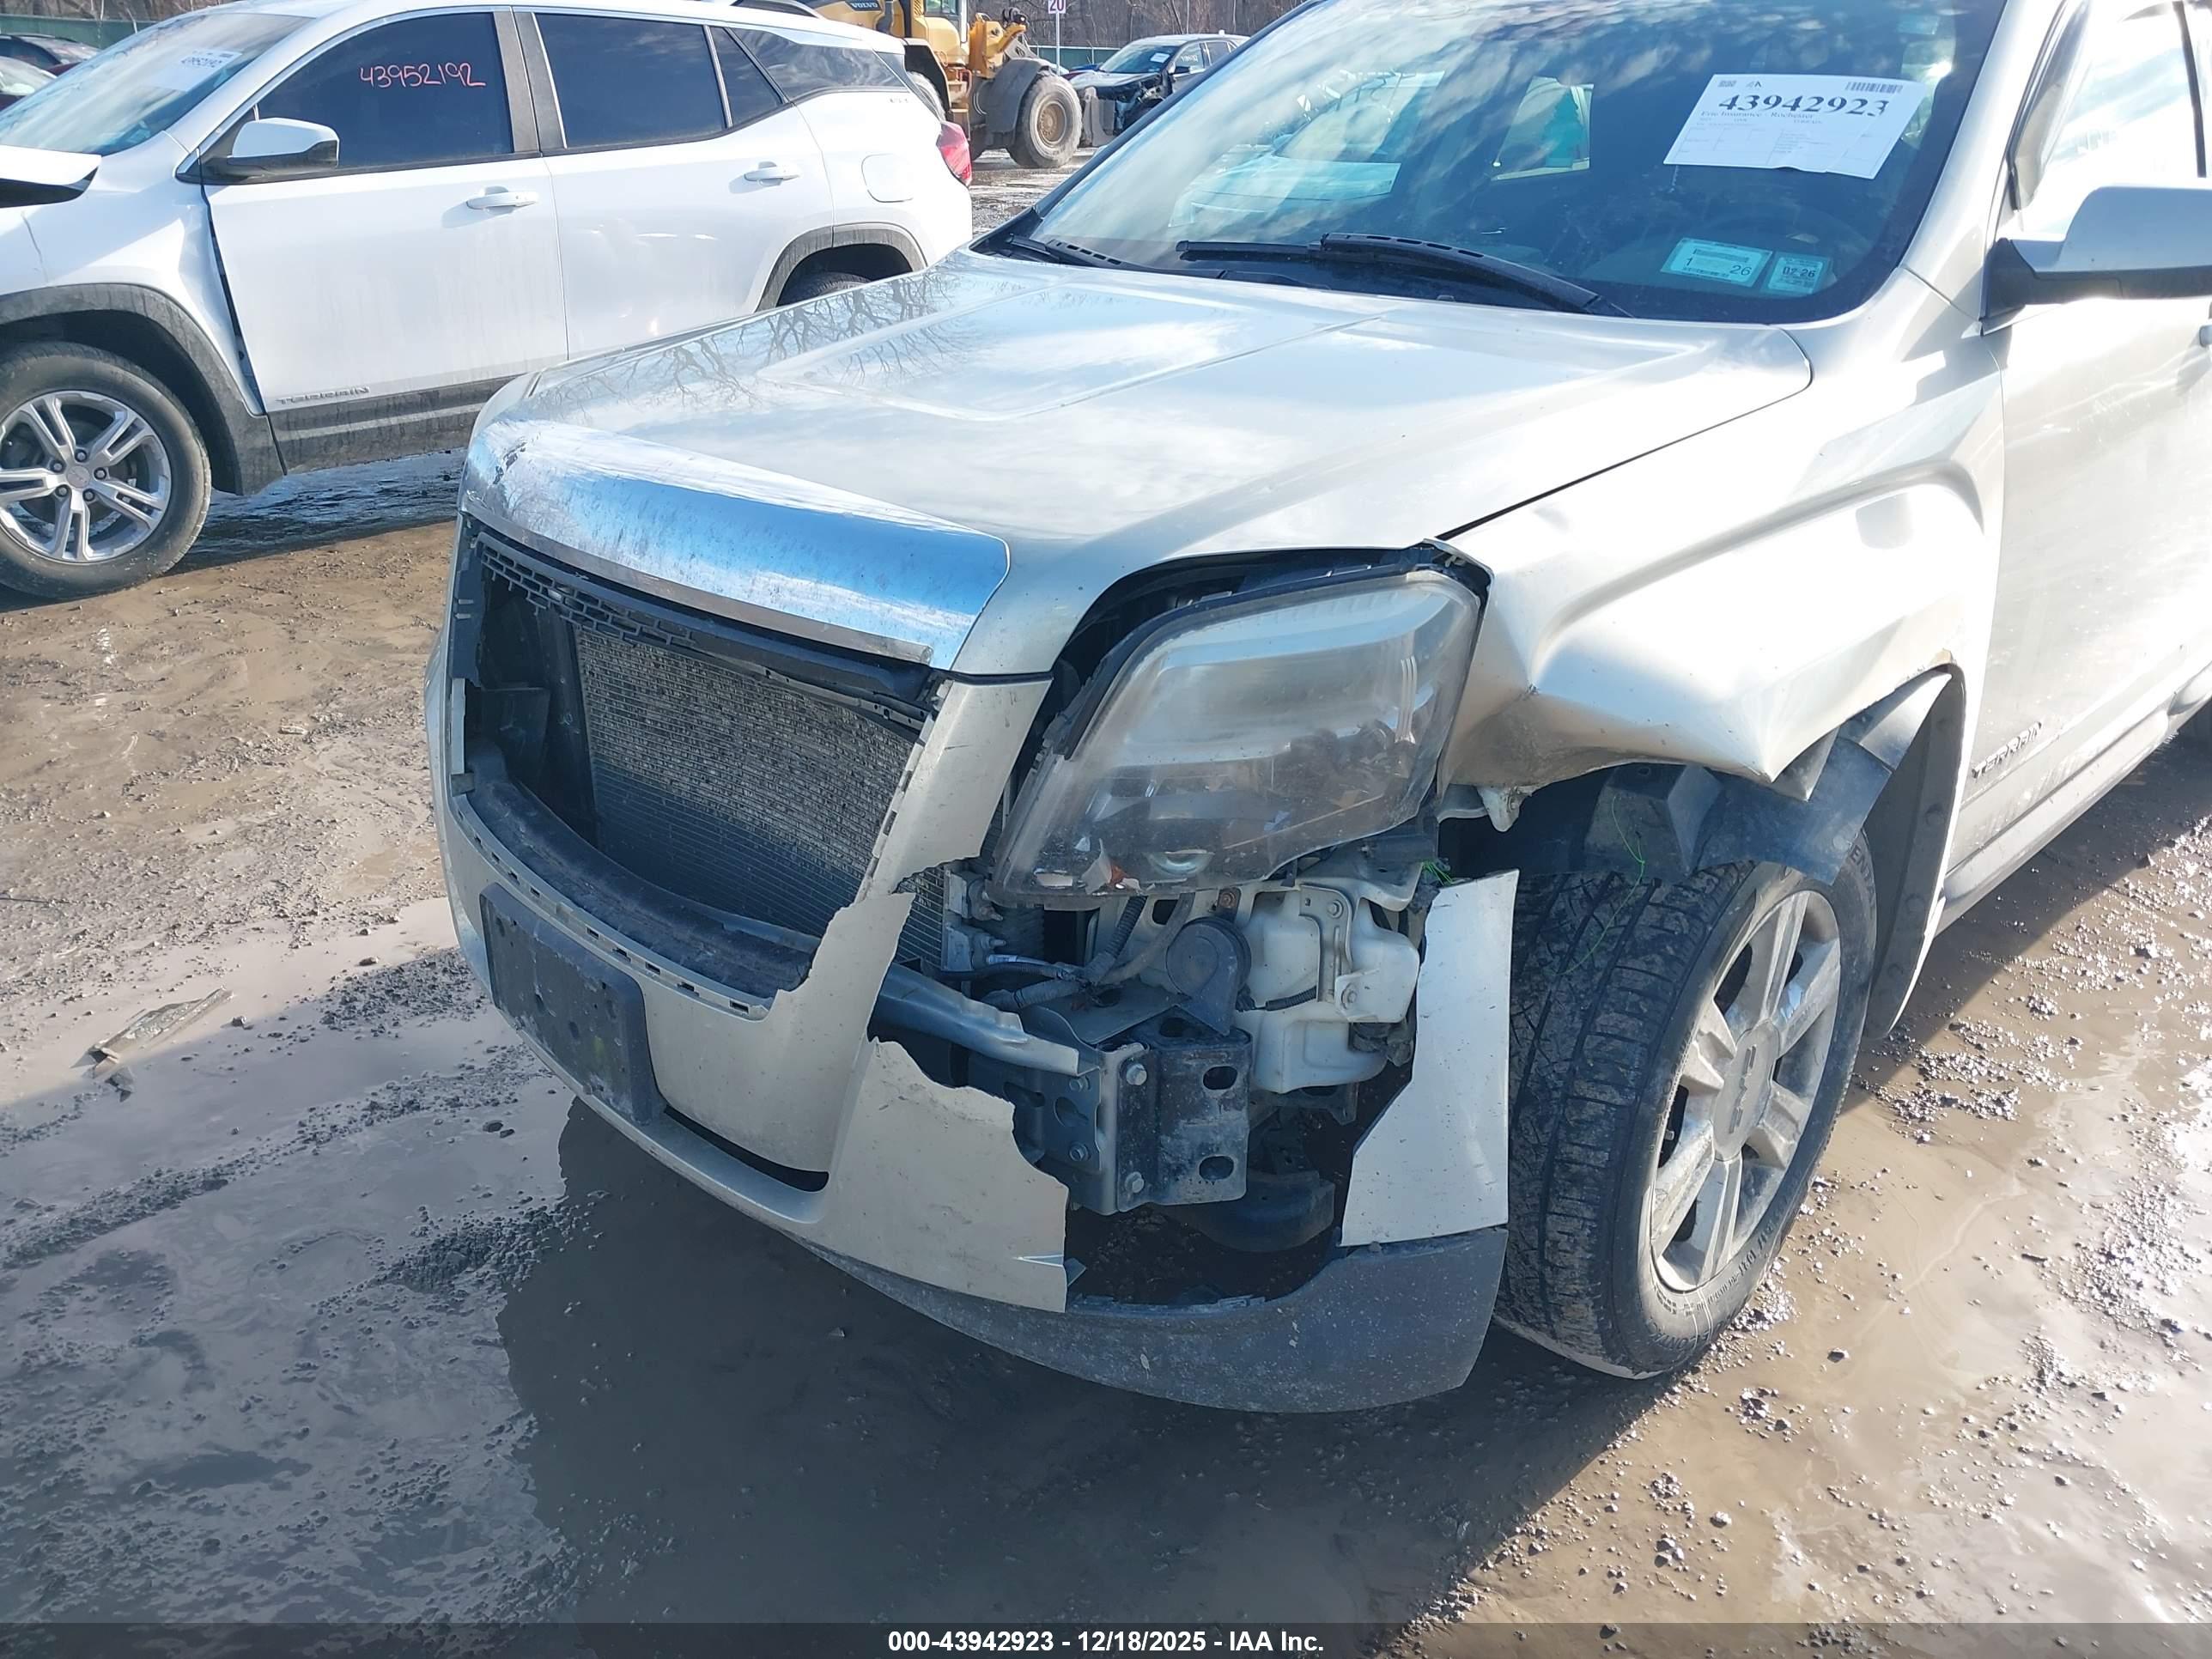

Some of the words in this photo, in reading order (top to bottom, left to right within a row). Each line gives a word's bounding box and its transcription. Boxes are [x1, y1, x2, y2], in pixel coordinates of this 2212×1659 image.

[1050, 0, 1064, 11] 20
[359, 62, 487, 88] 43952192
[1718, 94, 1890, 117] 43942923
[1729, 264, 1752, 276] 26
[275, 386, 370, 404] TERRAIN
